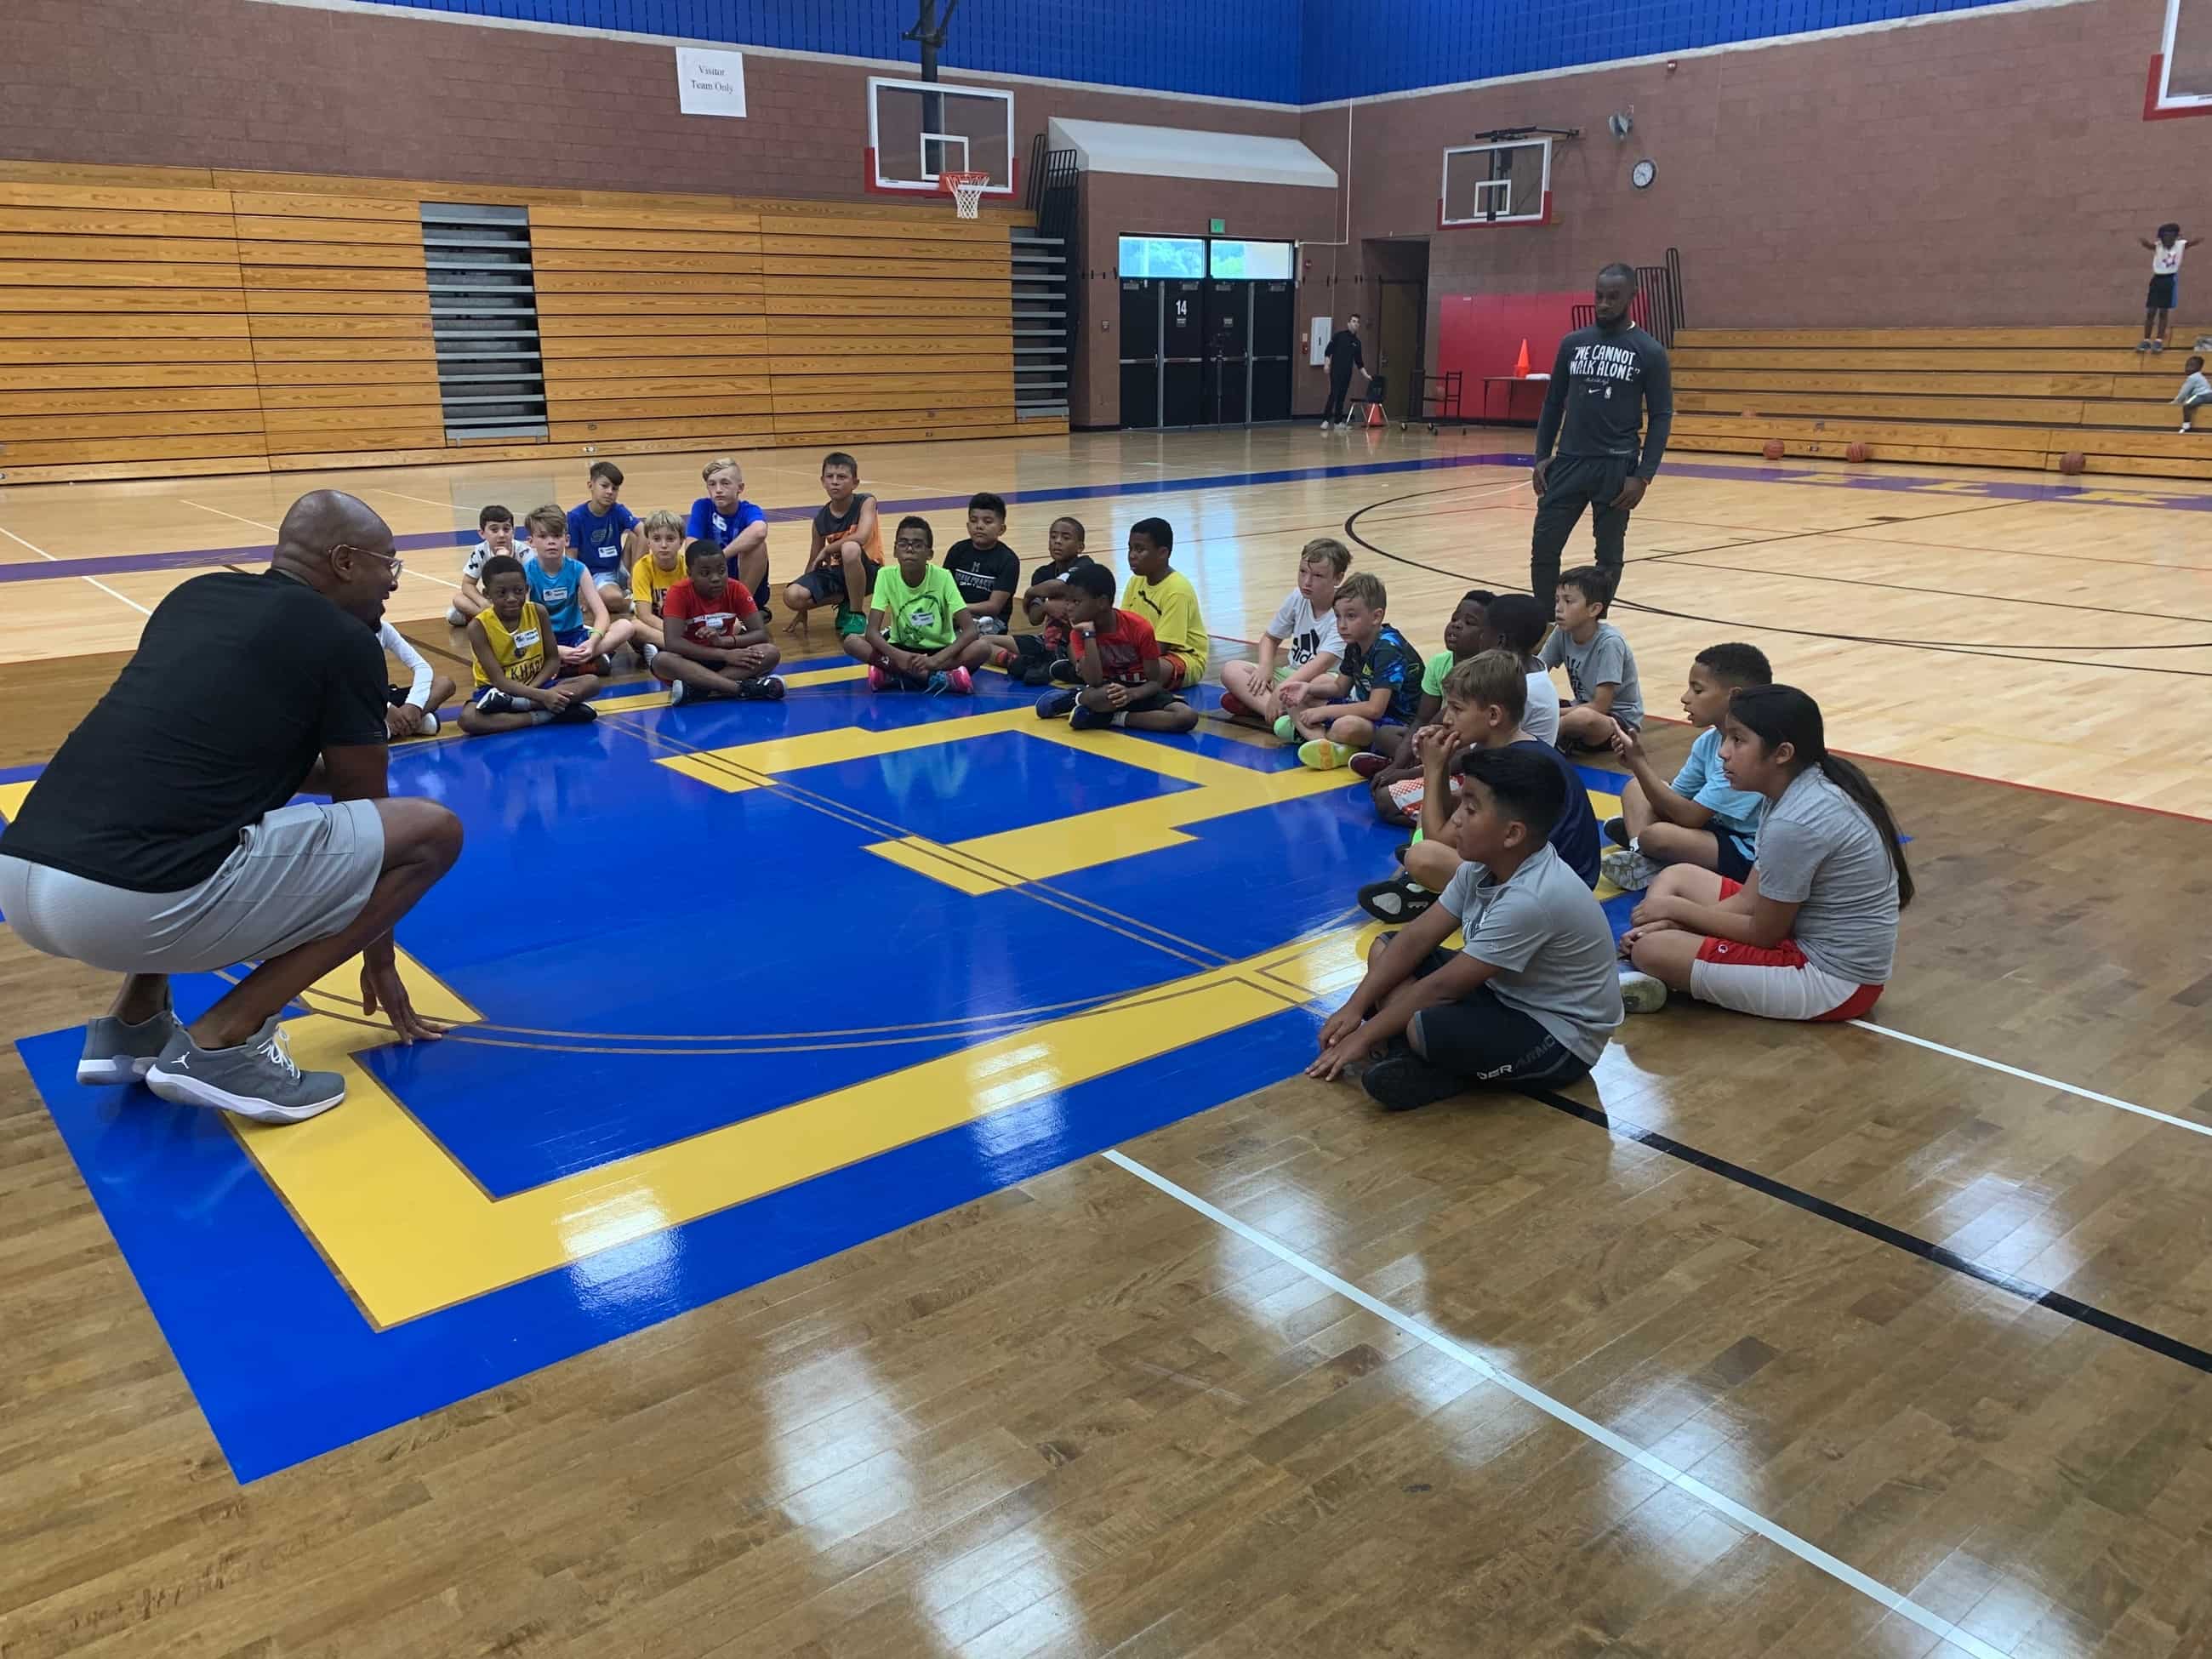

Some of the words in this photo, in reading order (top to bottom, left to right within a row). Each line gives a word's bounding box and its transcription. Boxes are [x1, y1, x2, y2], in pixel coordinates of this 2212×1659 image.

[698, 65, 726, 76] Visitor
[691, 80, 713, 90] Team
[715, 82, 733, 94] Only
[1176, 299, 1187, 315] 14
[1592, 345, 1635, 366] CANNOT
[1570, 360, 1597, 375] WALK
